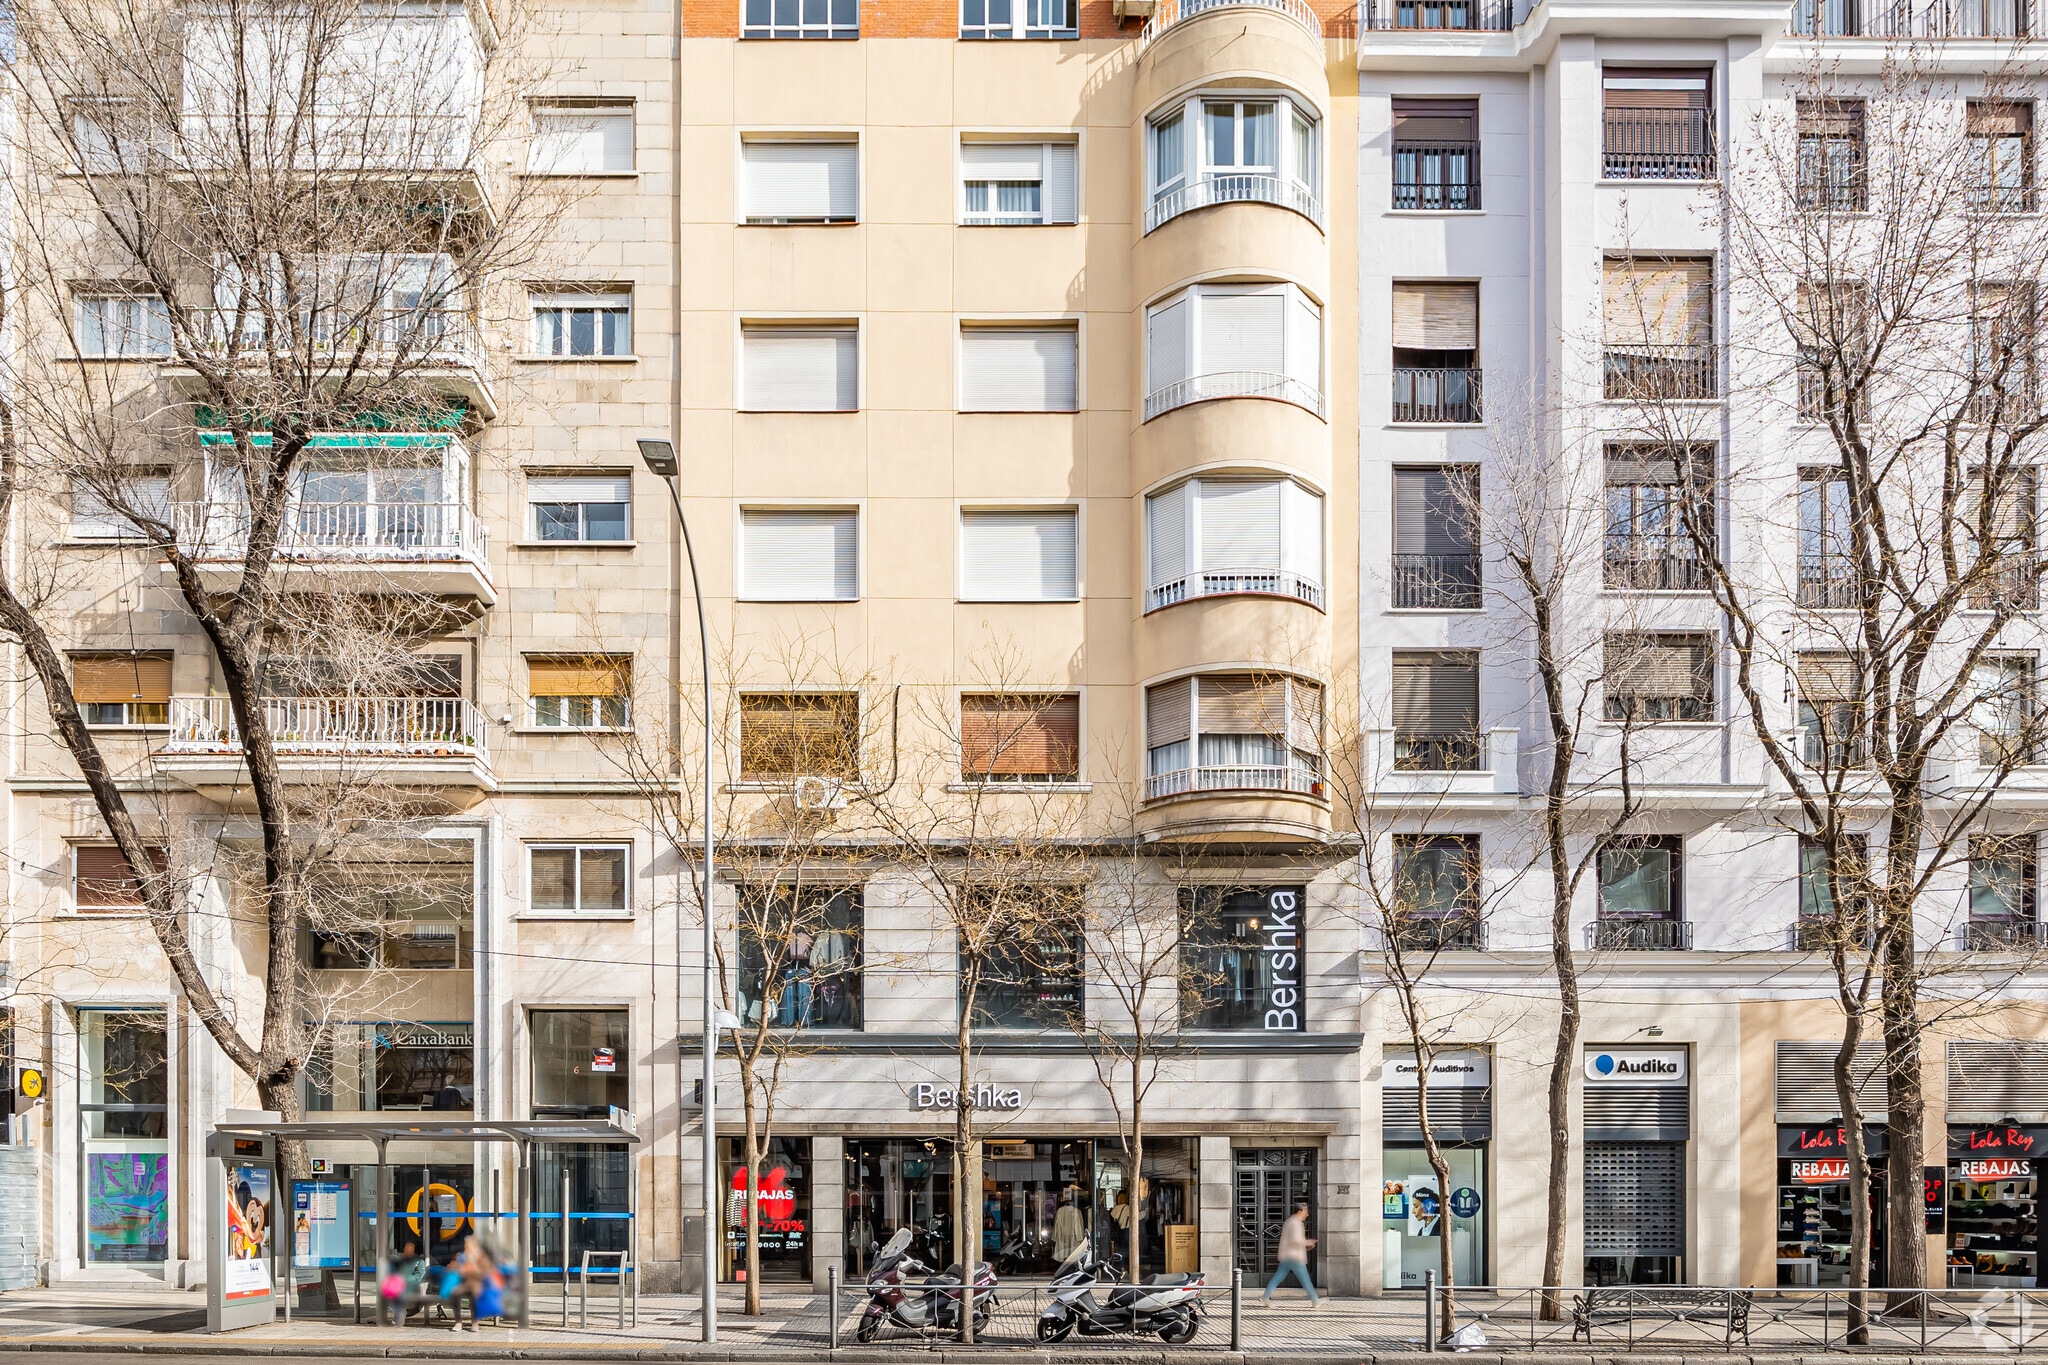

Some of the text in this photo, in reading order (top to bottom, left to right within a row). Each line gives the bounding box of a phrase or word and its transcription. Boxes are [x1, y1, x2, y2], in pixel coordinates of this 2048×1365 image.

[1262, 890, 1298, 1030] Bershka
[395, 1030, 473, 1045] CaixaBank
[573, 1065, 580, 1074] 6
[1396, 1064, 1475, 1073] Cent Auditivos
[1617, 1059, 1677, 1073] Audika
[1801, 1130, 1833, 1149] Lola
[1970, 1128, 2035, 1152] Lola Rey
[1792, 1162, 1850, 1177] REBAJA
[1961, 1161, 2030, 1175] REBAJAS
[734, 1189, 794, 1200] RAJAS
